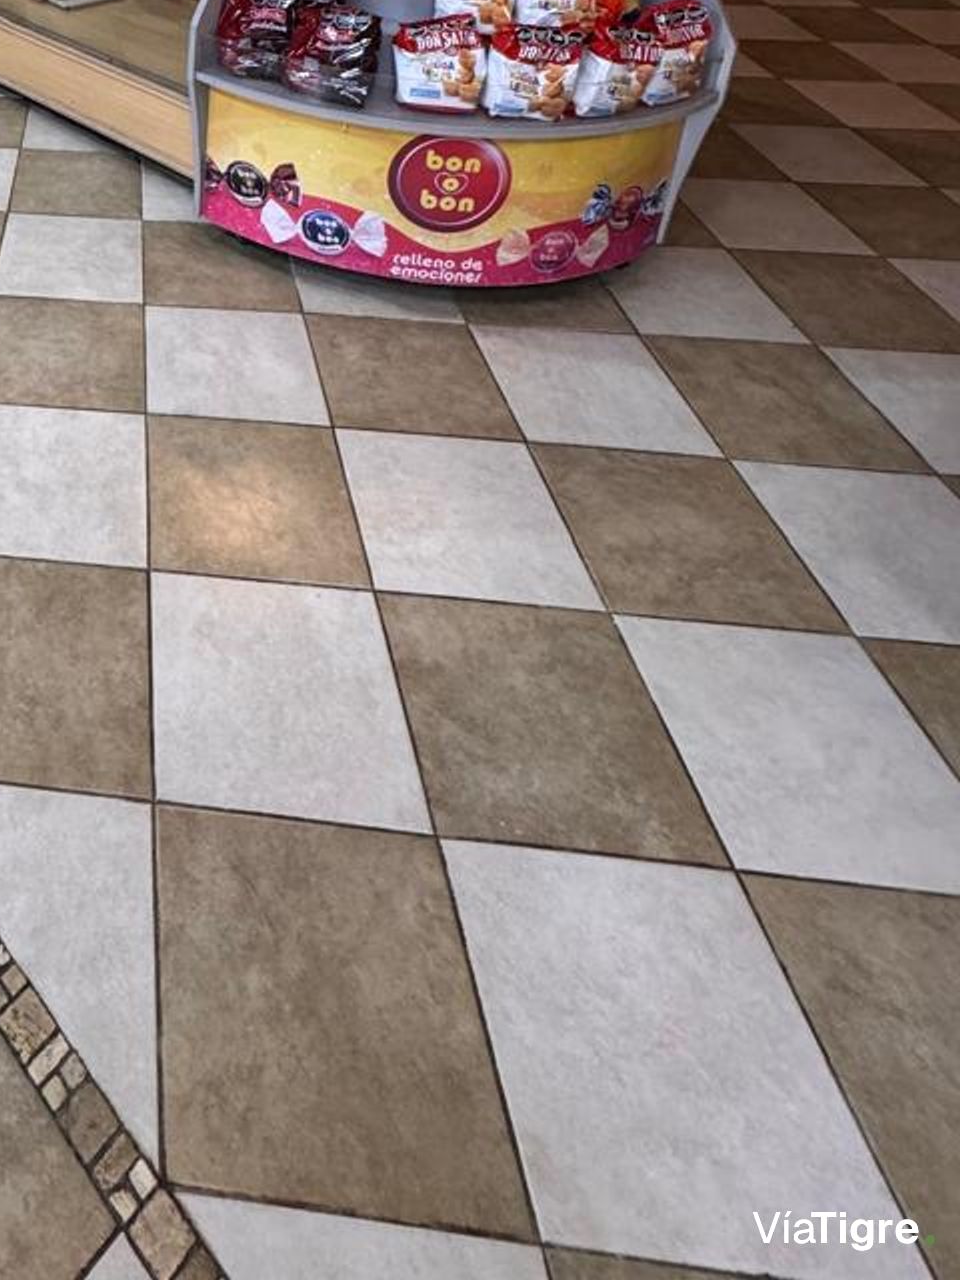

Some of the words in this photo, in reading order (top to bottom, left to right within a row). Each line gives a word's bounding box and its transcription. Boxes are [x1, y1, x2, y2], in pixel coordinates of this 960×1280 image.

[426, 149, 481, 173] bon
[420, 188, 475, 212] bon
[393, 253, 456, 270] relleno
[461, 258, 484, 271] de
[390, 266, 484, 284] emociones
